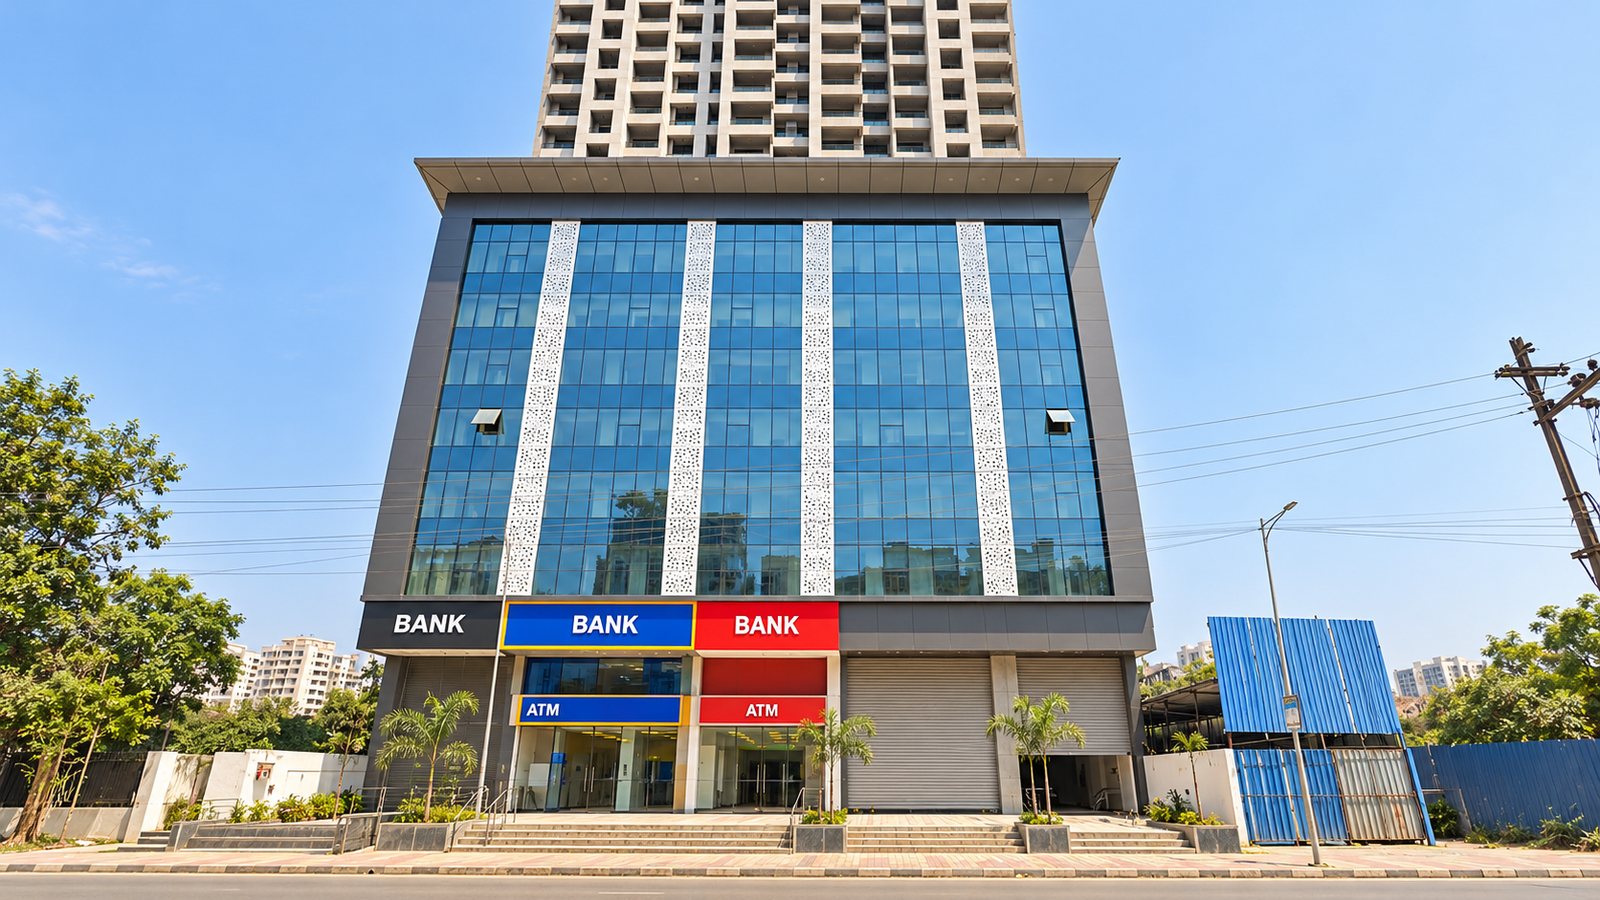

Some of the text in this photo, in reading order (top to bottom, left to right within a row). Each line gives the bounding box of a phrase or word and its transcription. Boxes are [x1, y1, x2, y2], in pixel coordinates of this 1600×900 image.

[393, 614, 466, 634] BANK
[572, 615, 639, 634] BANK
[735, 615, 800, 635] BANK
[526, 703, 560, 717] ATM
[746, 703, 779, 717] ATM
